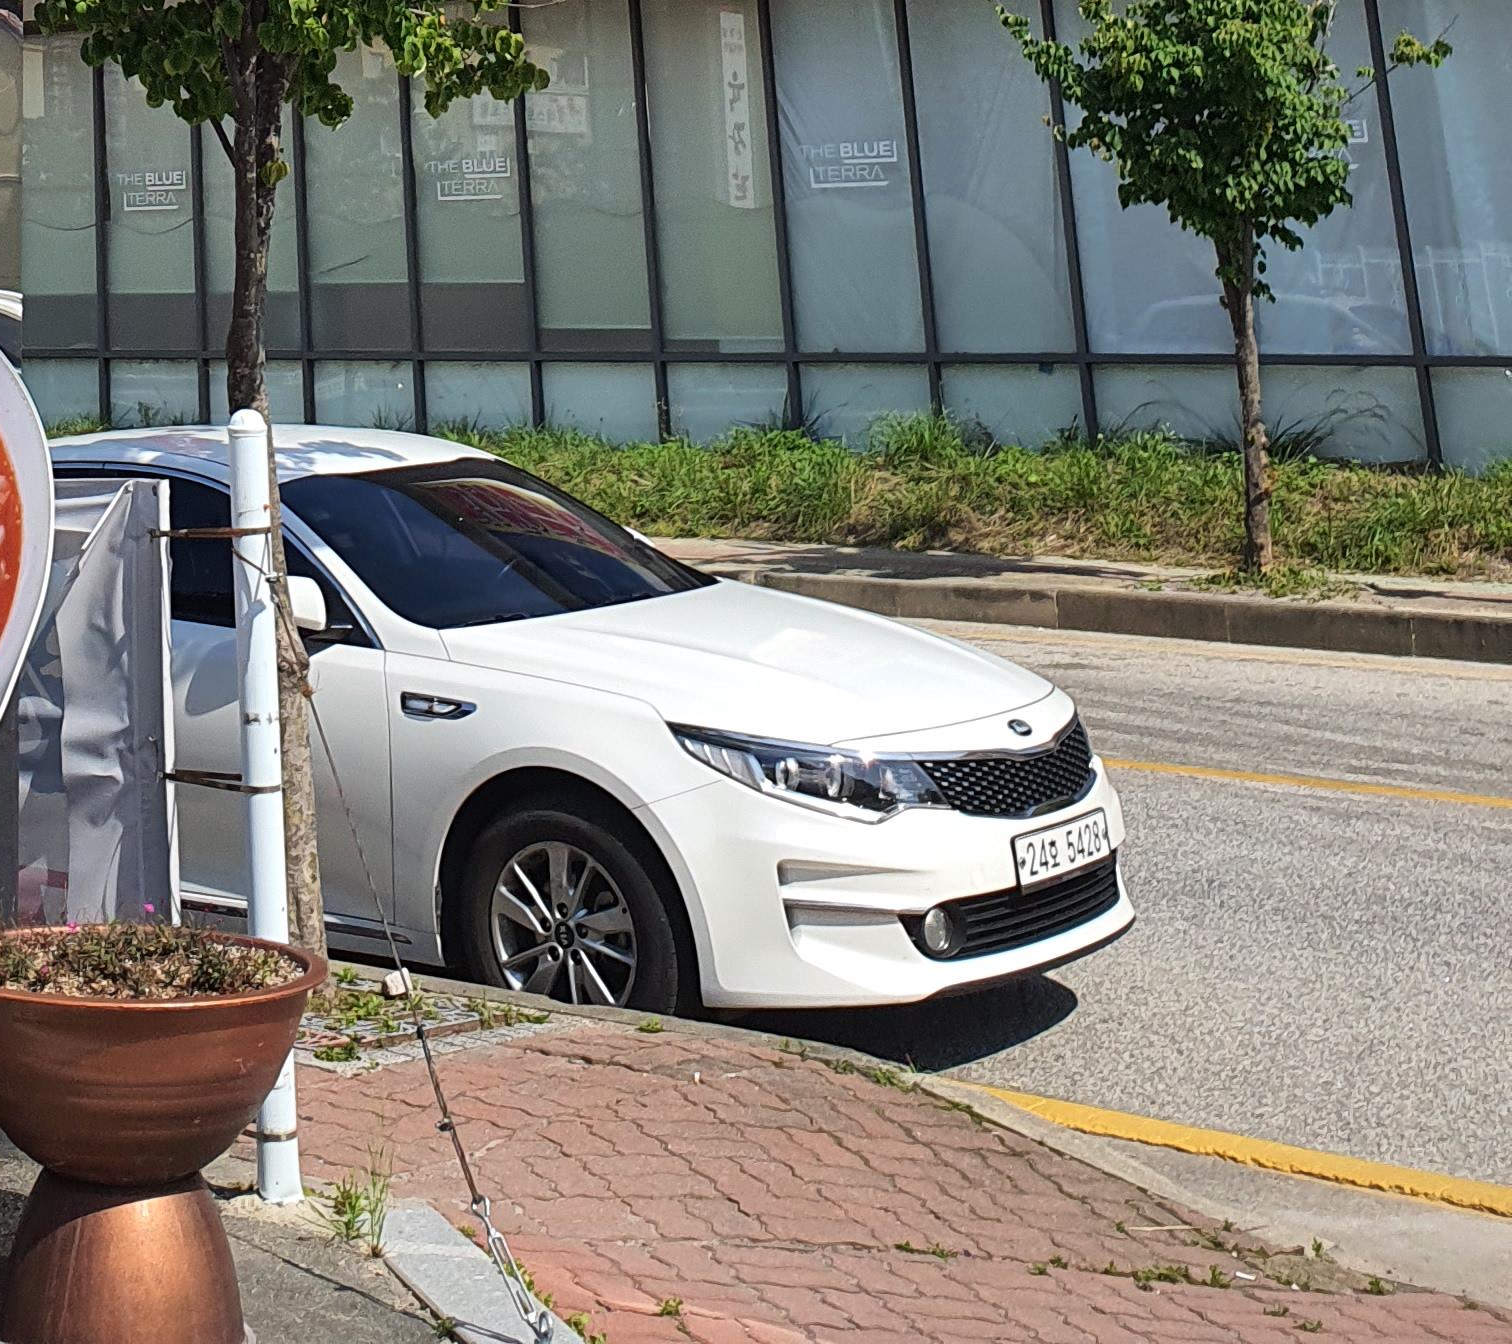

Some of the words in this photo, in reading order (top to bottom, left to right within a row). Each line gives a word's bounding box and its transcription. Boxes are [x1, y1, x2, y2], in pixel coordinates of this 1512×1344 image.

[798, 143, 836, 160] THE
[840, 140, 892, 157] BLUE
[430, 161, 459, 173] THE
[462, 158, 506, 173] BLUE
[815, 164, 885, 181] TERRA
[117, 173, 143, 186] THE
[145, 171, 182, 185] BLUE
[441, 180, 499, 195] TERRA
[128, 191, 177, 205] TERRA
[1065, 820, 1102, 863] 5428
